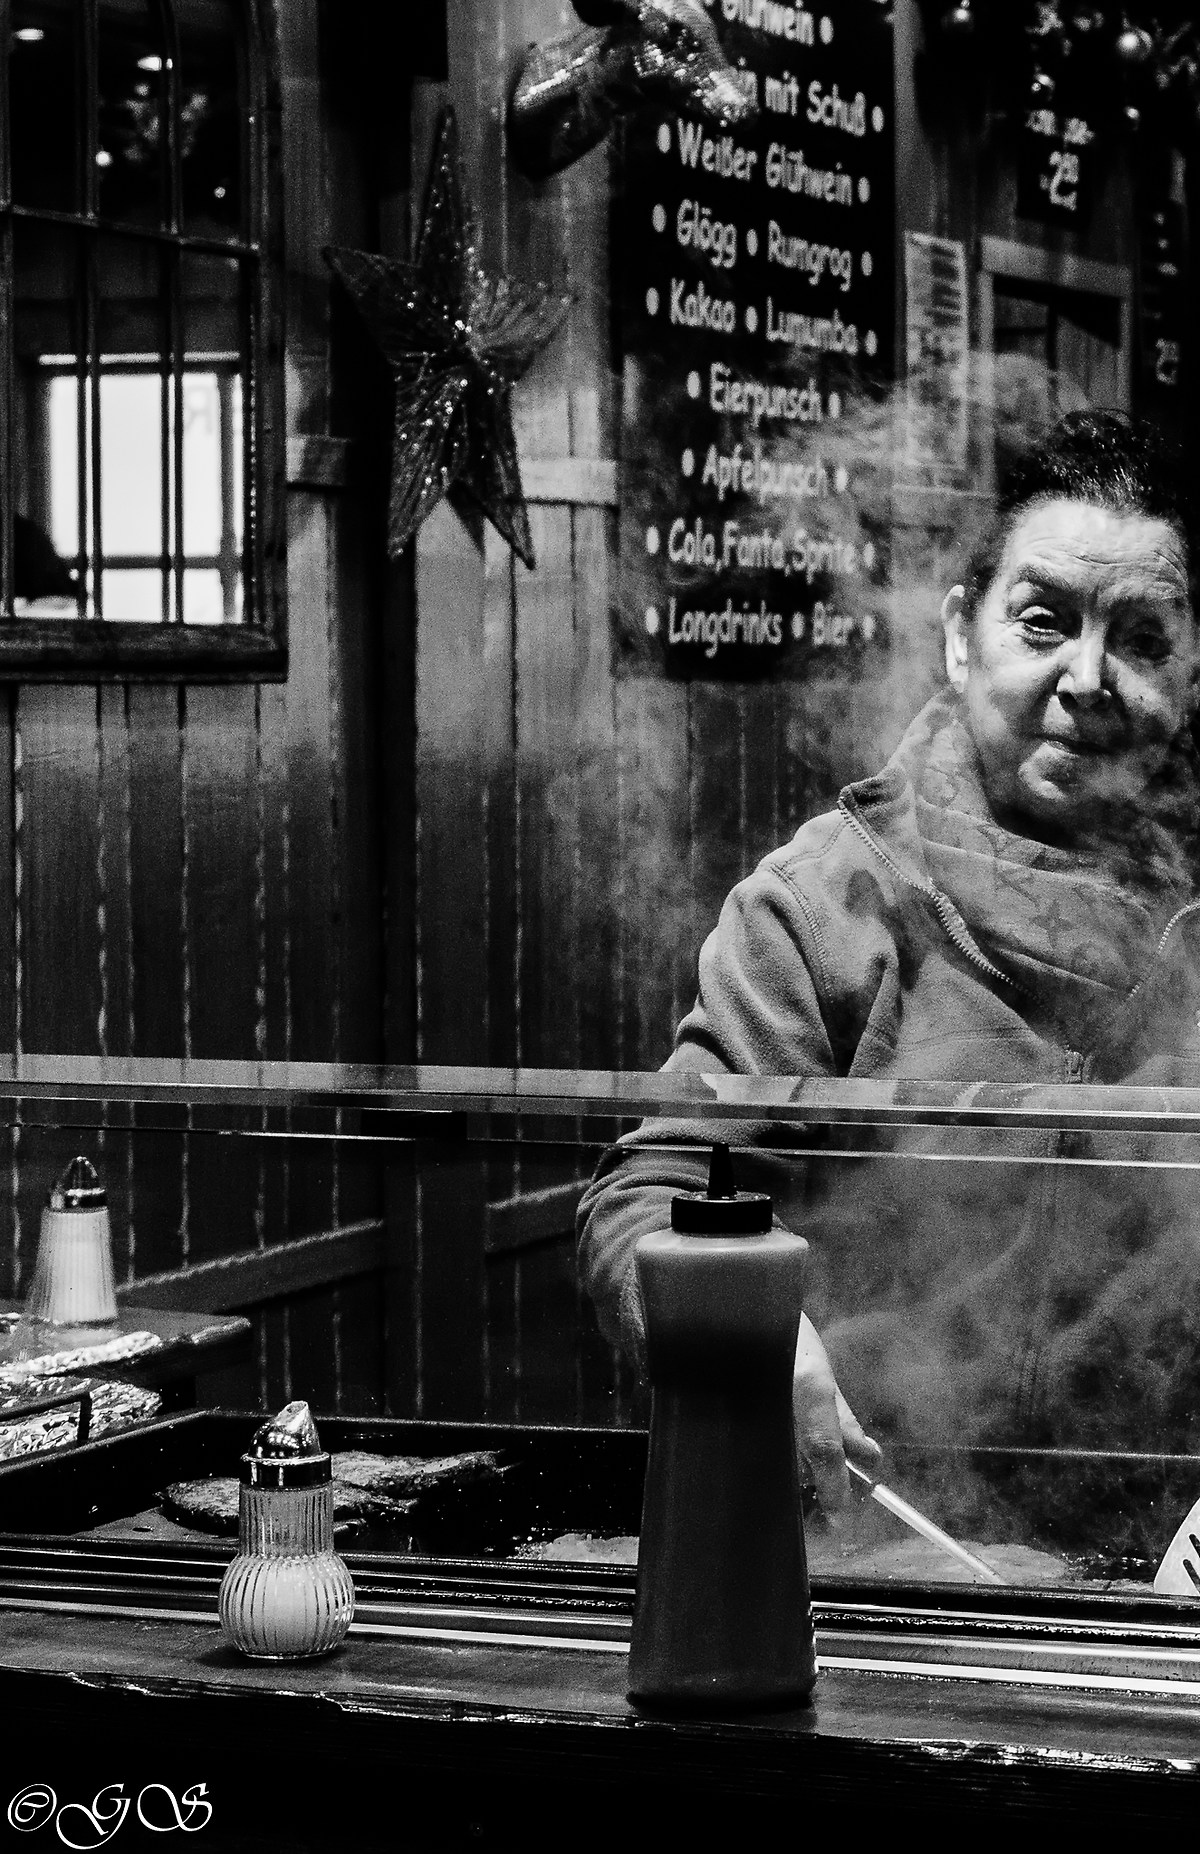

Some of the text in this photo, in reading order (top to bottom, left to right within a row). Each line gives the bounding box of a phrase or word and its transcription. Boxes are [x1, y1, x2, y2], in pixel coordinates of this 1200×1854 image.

[765, 70, 799, 116] mit
[677, 117, 852, 206] Weißer Glühwein
[676, 198, 851, 292] Glögg Rumgrog
[669, 277, 858, 355] Kakao Lumumba
[668, 598, 854, 659] Longdrinks Bier
